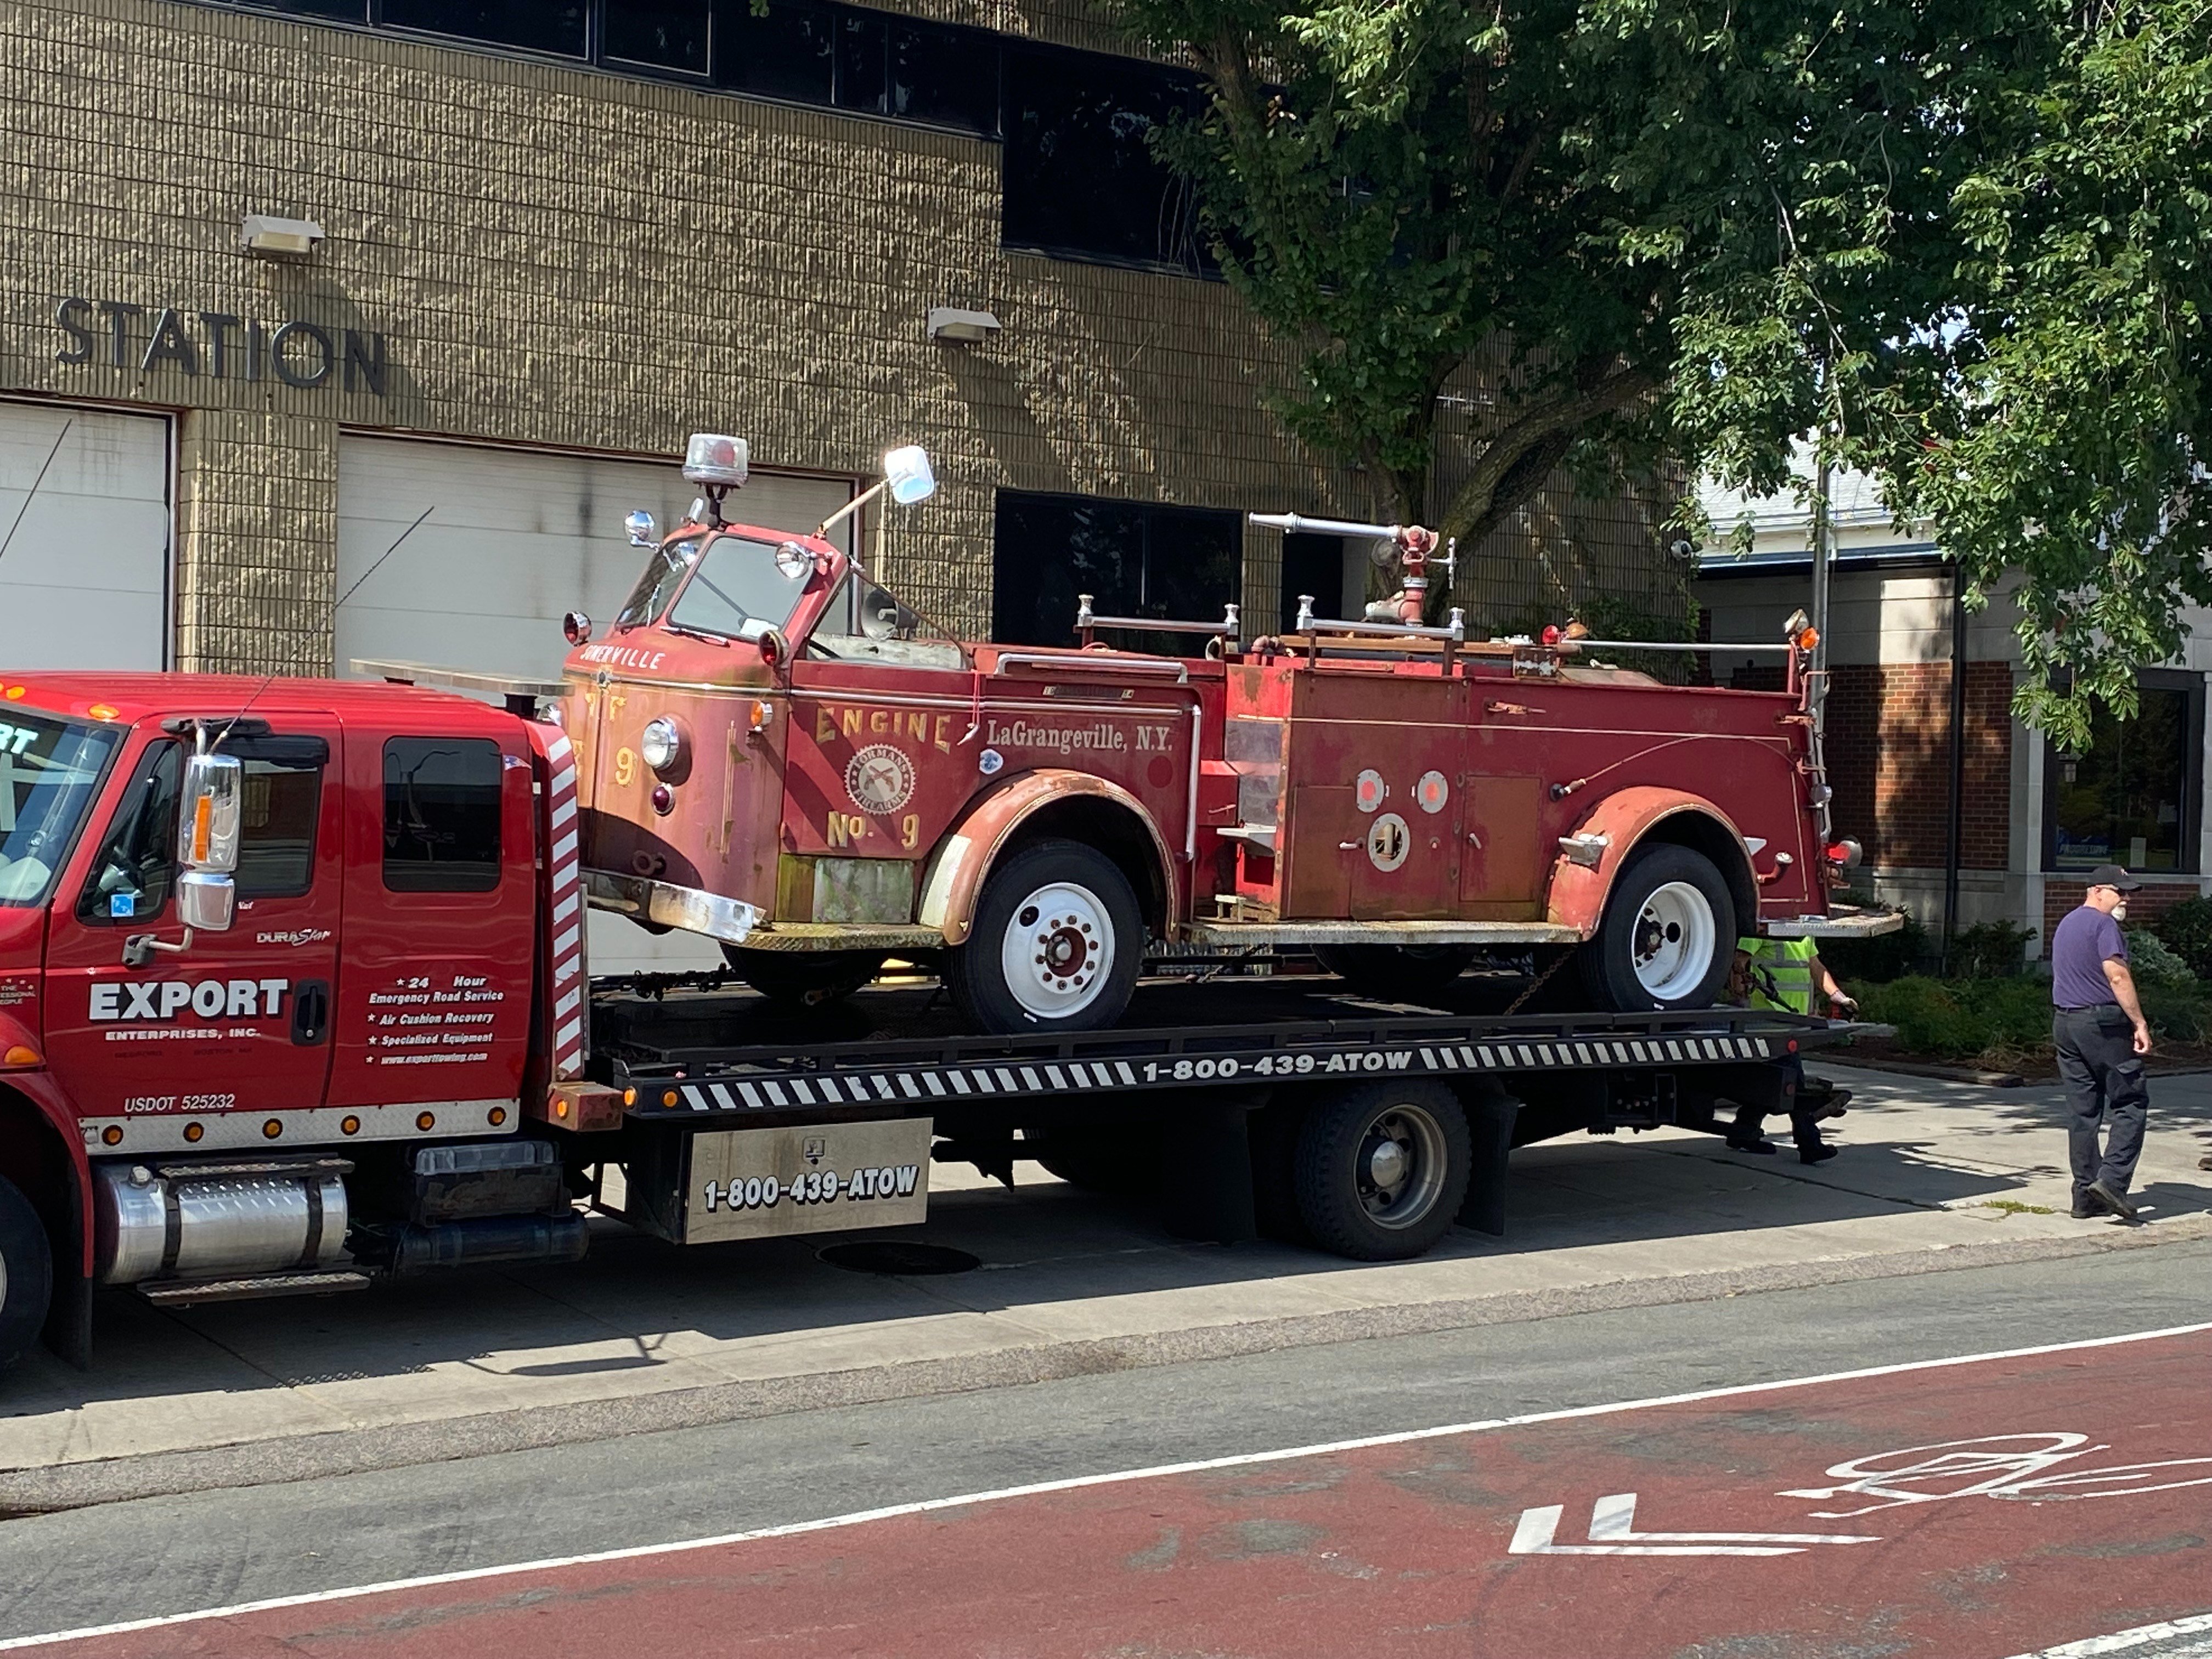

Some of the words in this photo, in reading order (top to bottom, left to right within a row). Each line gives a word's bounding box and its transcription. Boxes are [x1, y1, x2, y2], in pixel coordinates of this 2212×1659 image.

[55, 296, 385, 396] STATION
[580, 645, 667, 670] SOMERVILLE
[816, 707, 951, 755] ENGINE
[987, 720, 1127, 755] LaGrangeville,
[1136, 725, 1173, 751] N.Y.
[615, 747, 638, 788] 9
[853, 748, 908, 773] FORMANS
[852, 788, 907, 811] FIREARMS
[901, 814, 919, 851] 9
[408, 977, 430, 989] 24
[453, 975, 487, 987] Hour
[89, 979, 288, 1021] EXPORT
[368, 992, 430, 1005] Emergency
[432, 991, 461, 1002] Road
[464, 990, 504, 1001] Service
[379, 1014, 397, 1025] Air
[399, 1013, 442, 1025] Cushion
[444, 1012, 495, 1024] Recovery
[105, 1029, 223, 1041] ENTERPRISES,
[228, 1028, 262, 1037] INC.
[381, 1034, 439, 1047] Specialized
[442, 1032, 493, 1045] Equipment
[1143, 1051, 1413, 1082] 1-800-439-ATOW
[124, 1097, 177, 1113] USDOT
[180, 1093, 236, 1110] 525232
[704, 1165, 919, 1212] 1-800-439-ATOW
